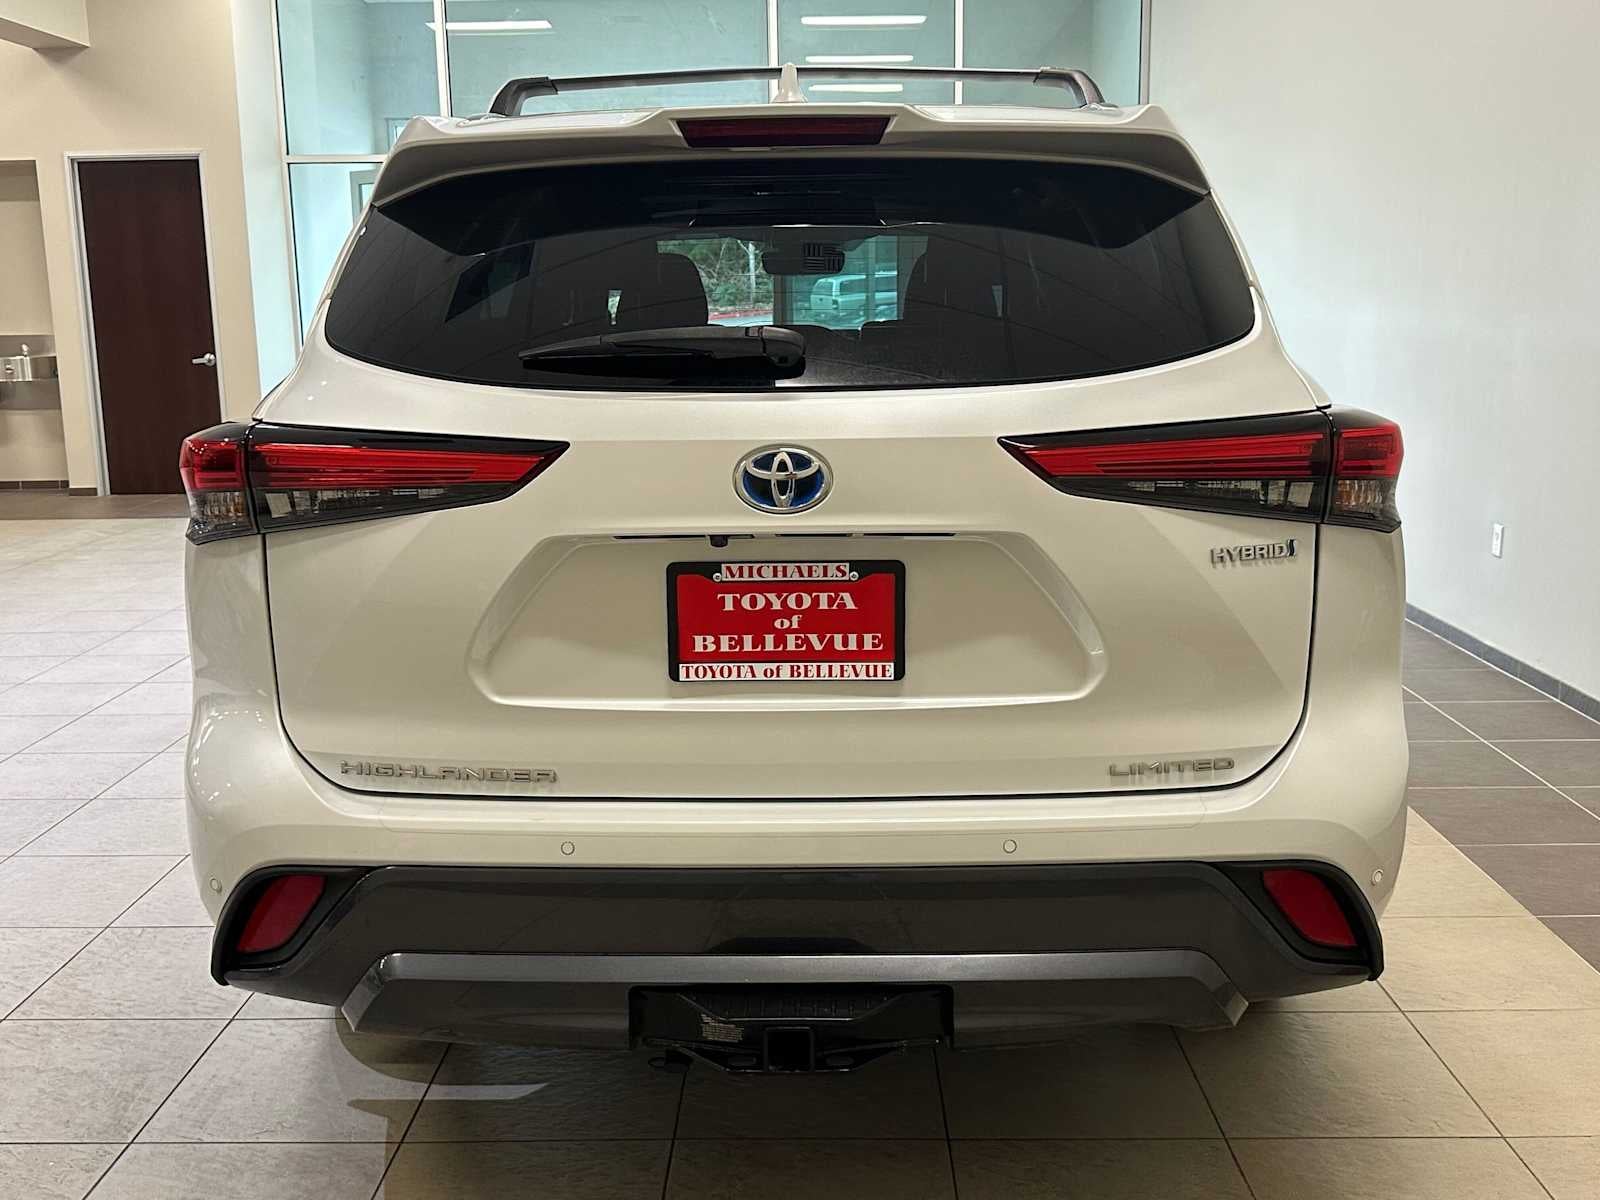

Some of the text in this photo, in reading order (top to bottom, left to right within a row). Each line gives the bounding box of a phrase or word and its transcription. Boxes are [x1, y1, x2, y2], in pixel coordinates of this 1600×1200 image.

[1210, 543, 1288, 563] HYBRID
[724, 564, 848, 580] MICHAELS
[717, 592, 858, 611] TOYOTA
[774, 614, 802, 629] of
[692, 633, 883, 652] BELLEVUE
[681, 663, 893, 679] TOYOTA of BELLEVUE
[340, 759, 558, 783] HIGHLANDER
[1109, 758, 1235, 777] LIMITED
